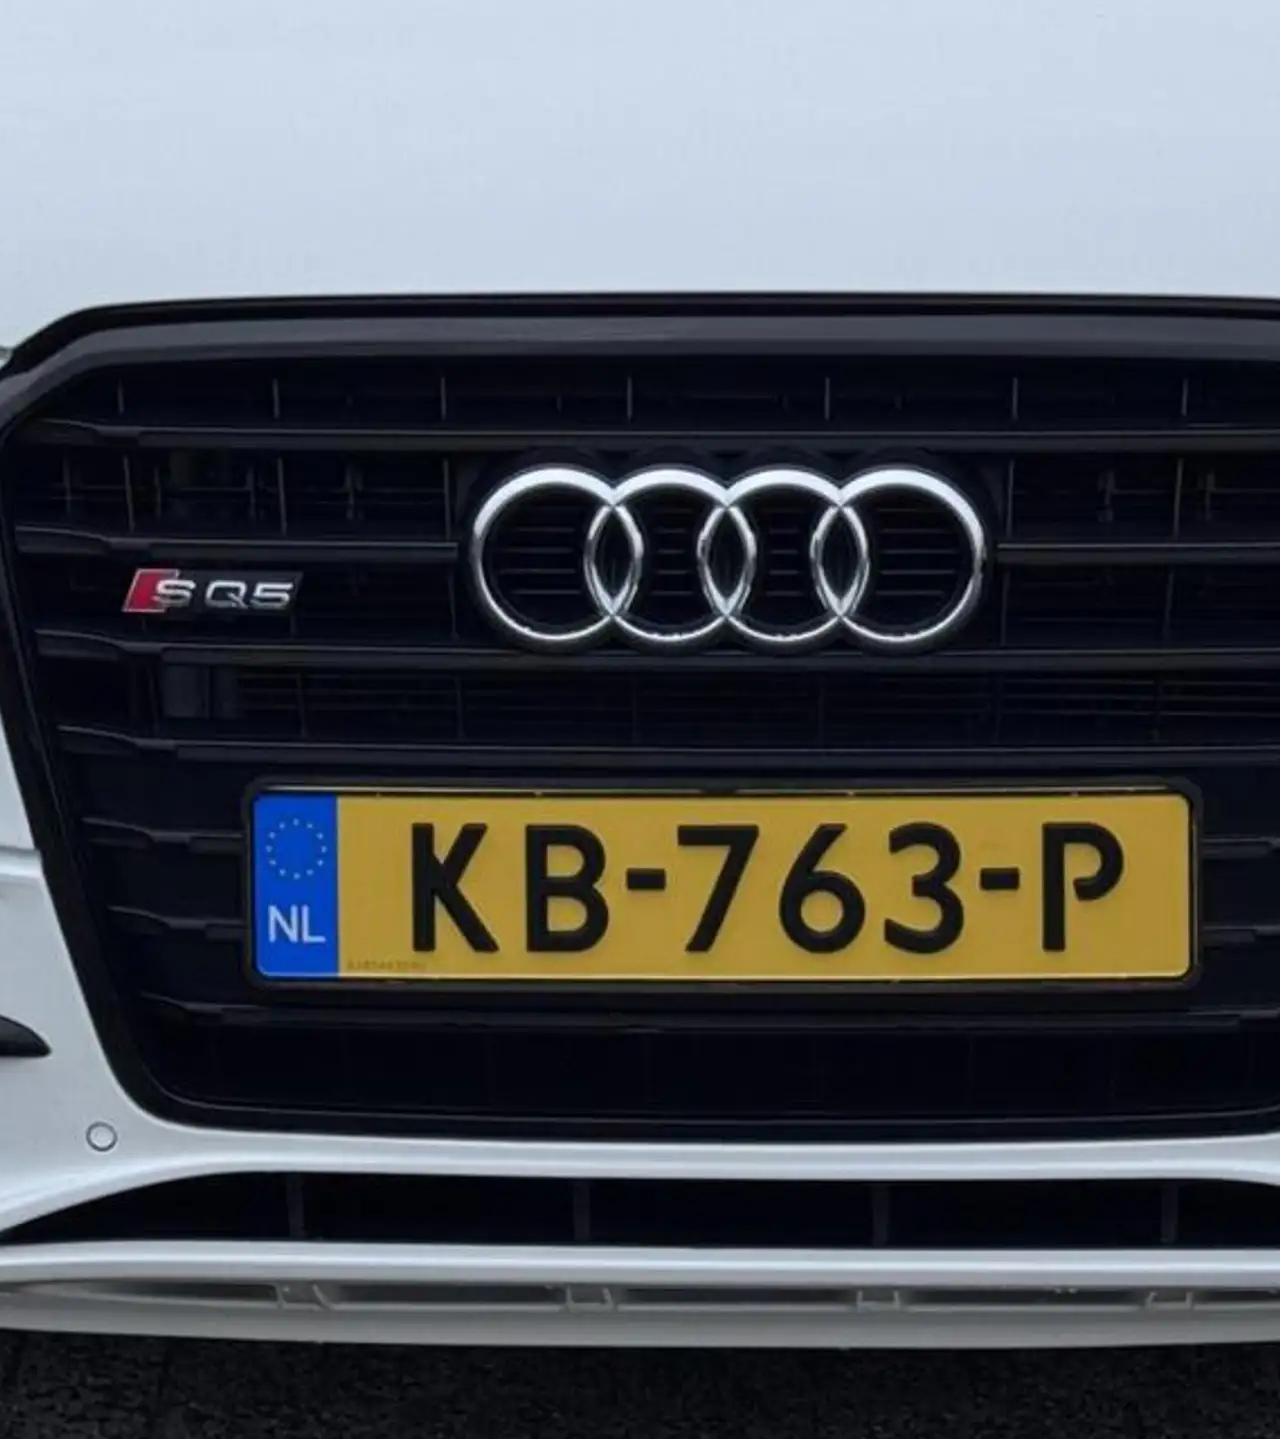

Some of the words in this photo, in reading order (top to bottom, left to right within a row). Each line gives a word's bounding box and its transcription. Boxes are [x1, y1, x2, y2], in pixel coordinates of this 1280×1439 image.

[153, 579, 294, 609] SQ5
[410, 821, 1125, 954] KB-763-P
[269, 905, 325, 944] NL
